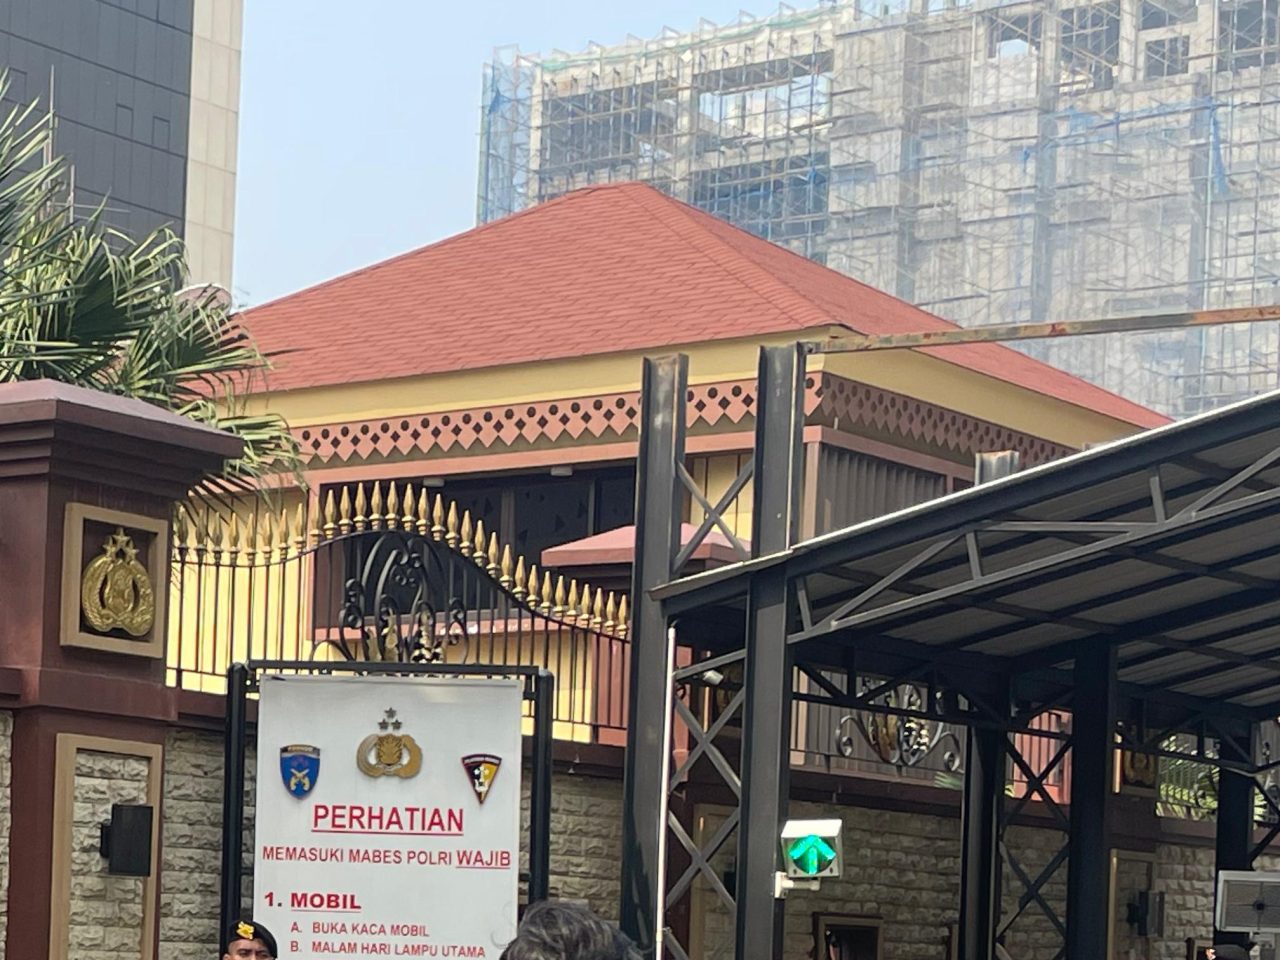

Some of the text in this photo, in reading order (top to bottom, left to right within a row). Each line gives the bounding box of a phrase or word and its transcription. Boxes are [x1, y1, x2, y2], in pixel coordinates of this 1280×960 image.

[312, 804, 464, 832] PERHATIAN
[262, 846, 511, 867] MEMASUKI MABES POLRI WAJIB
[264, 892, 362, 910] 1. MOBIL
[290, 922, 430, 937] A. BUKA KACA MOBIL
[290, 941, 486, 958] B. MALAM HARI LAMPU UTAMA
